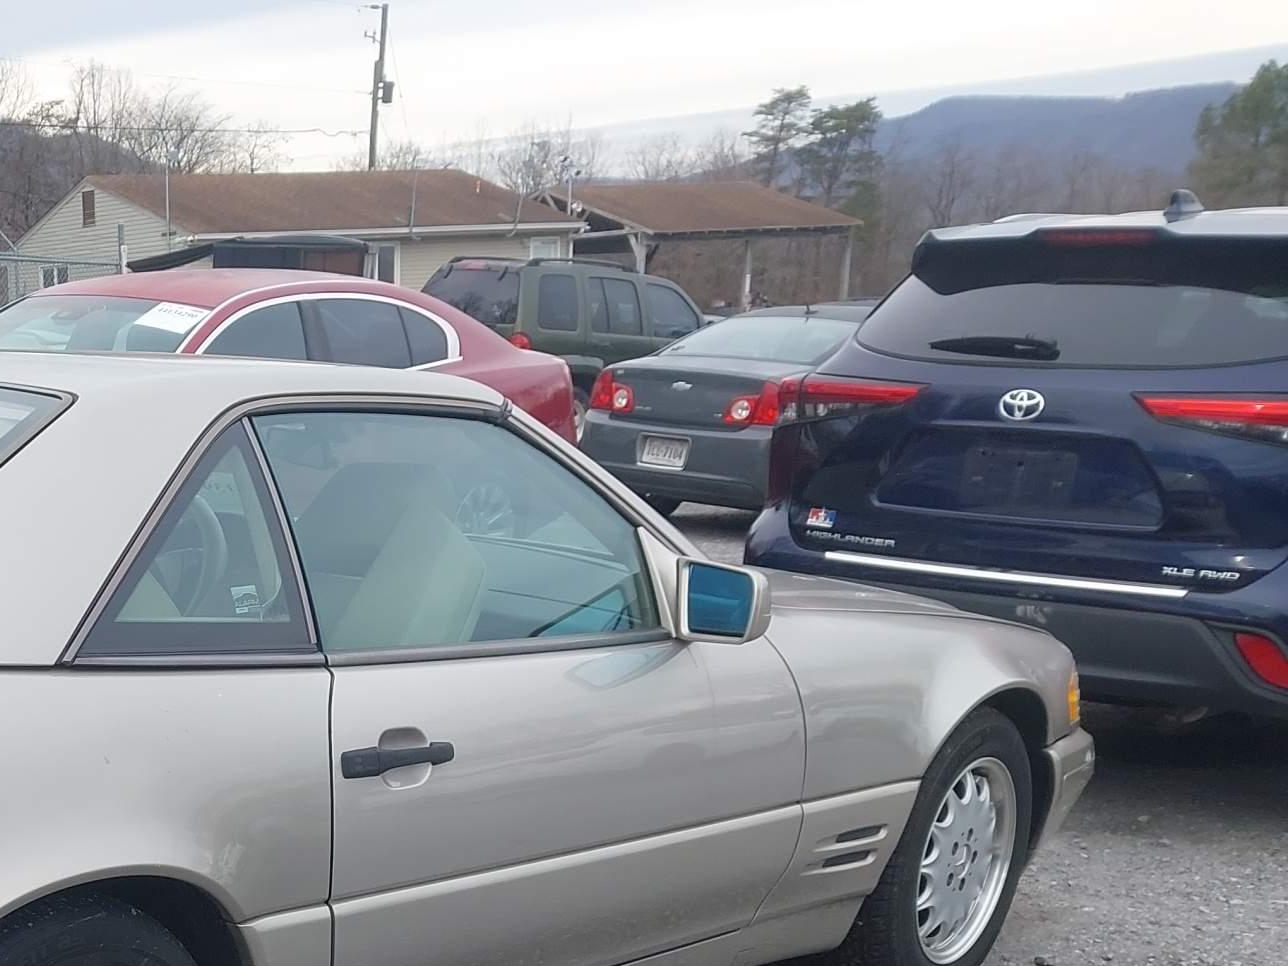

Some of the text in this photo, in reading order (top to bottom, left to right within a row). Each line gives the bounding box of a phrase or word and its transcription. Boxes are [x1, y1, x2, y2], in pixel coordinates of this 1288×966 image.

[806, 529, 896, 548] HIGHLANDER
[1162, 566, 1241, 580] XLE AWD
